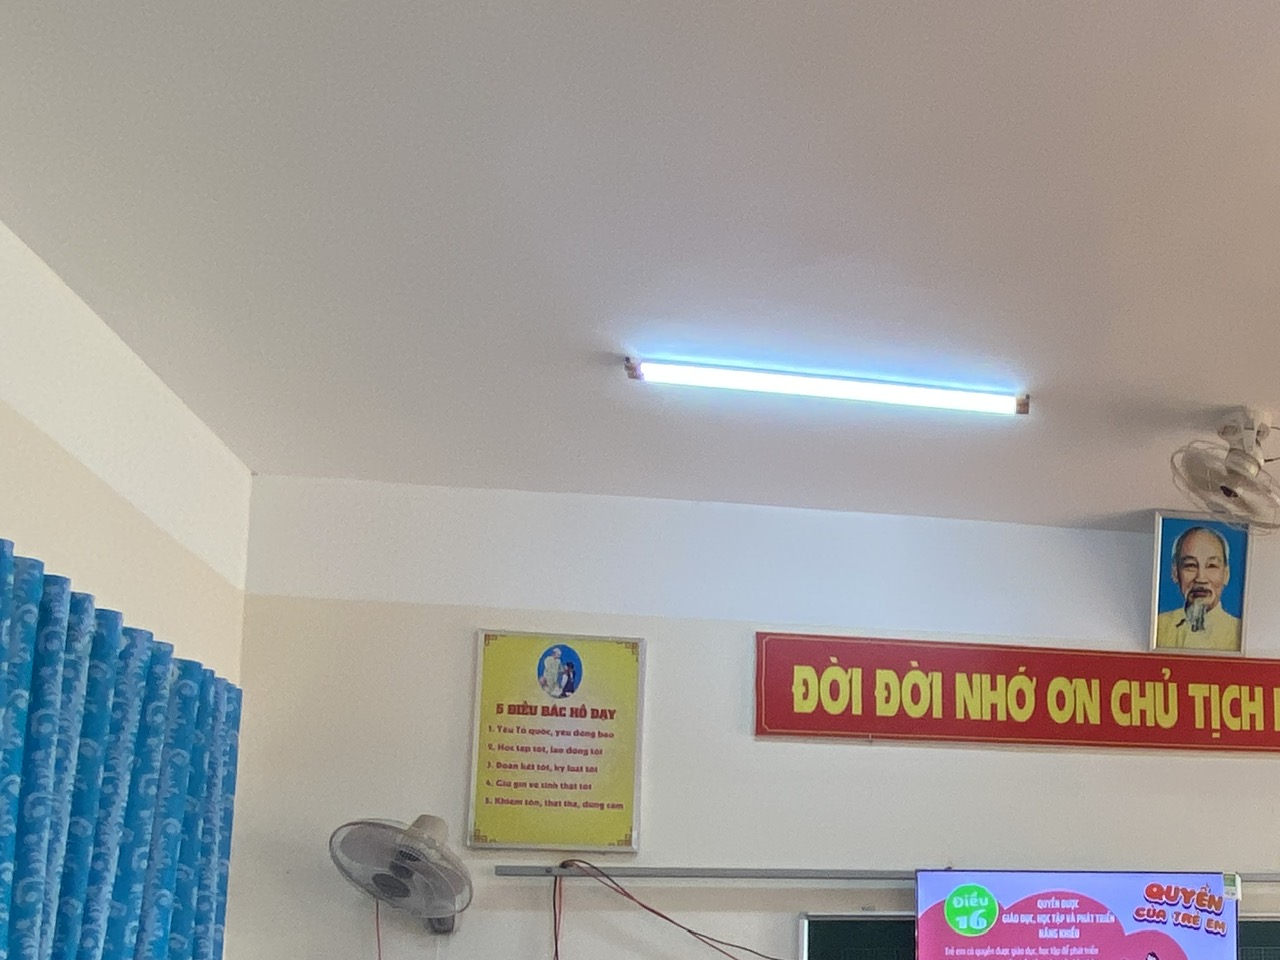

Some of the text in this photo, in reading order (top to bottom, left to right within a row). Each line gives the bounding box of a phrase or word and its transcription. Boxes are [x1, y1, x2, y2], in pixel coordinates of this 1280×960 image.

[496, 703, 504, 715] 5
[792, 656, 862, 715] ĐỜI
[875, 660, 943, 718] ĐỜI
[955, 666, 1037, 722] NHỚ
[1047, 676, 1101, 725] ƠN
[1110, 668, 1178, 728] CHỦ
[1188, 683, 1264, 738] TỊCH
[1144, 882, 1224, 914] QUYỀN
[955, 909, 988, 929] 16
[1134, 904, 1167, 921] CỦA
[1206, 917, 1227, 934] EM
